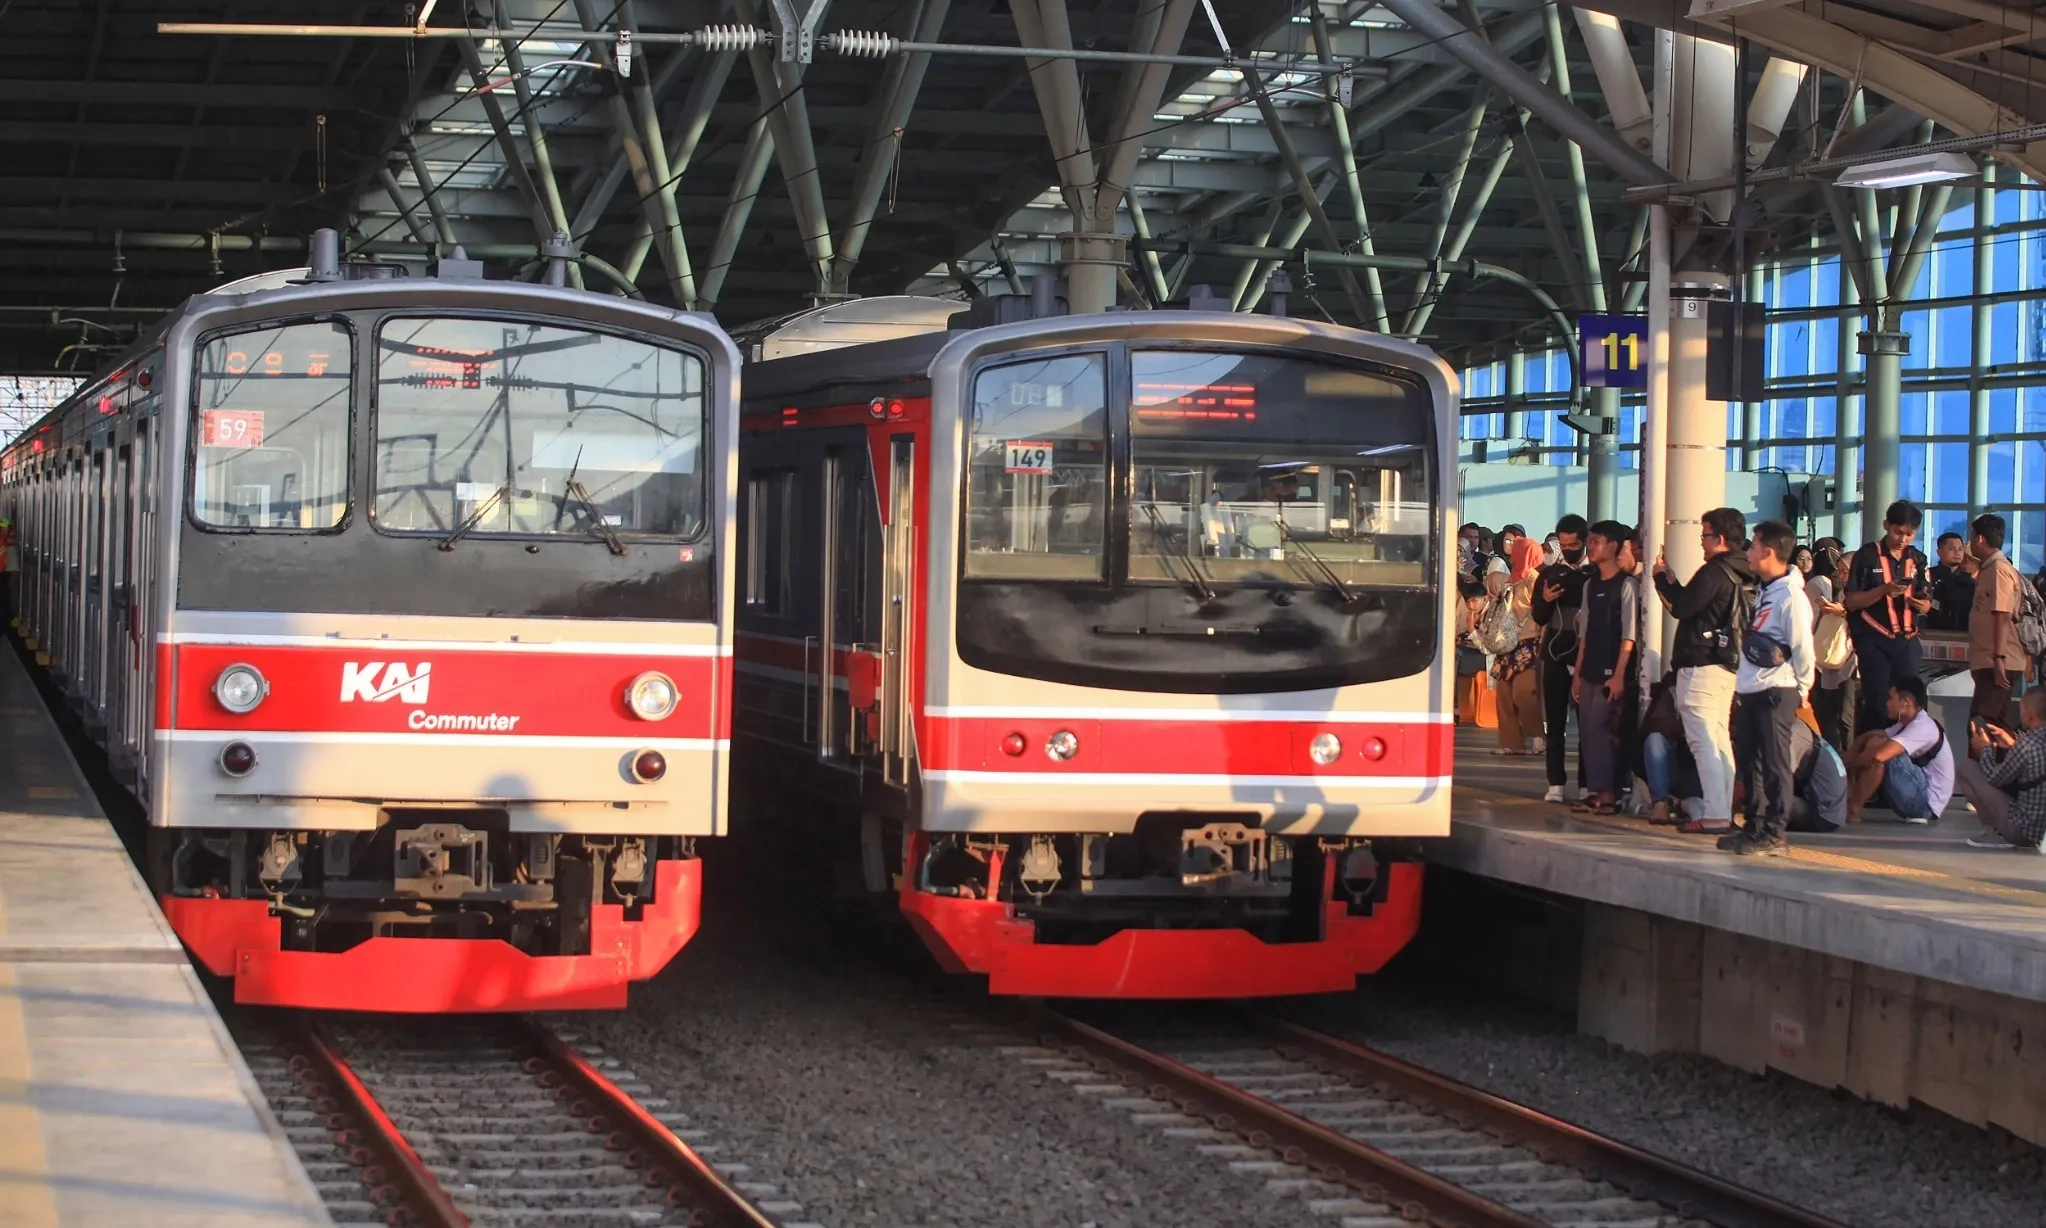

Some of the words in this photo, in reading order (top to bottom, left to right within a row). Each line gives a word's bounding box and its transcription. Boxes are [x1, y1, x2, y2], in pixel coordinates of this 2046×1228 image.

[1688, 302, 1697, 312] 9
[1601, 332, 1638, 370] 11
[220, 418, 247, 440] 59
[1012, 449, 1046, 468] 149
[340, 661, 432, 704] KAI
[408, 709, 520, 731] Commuter
